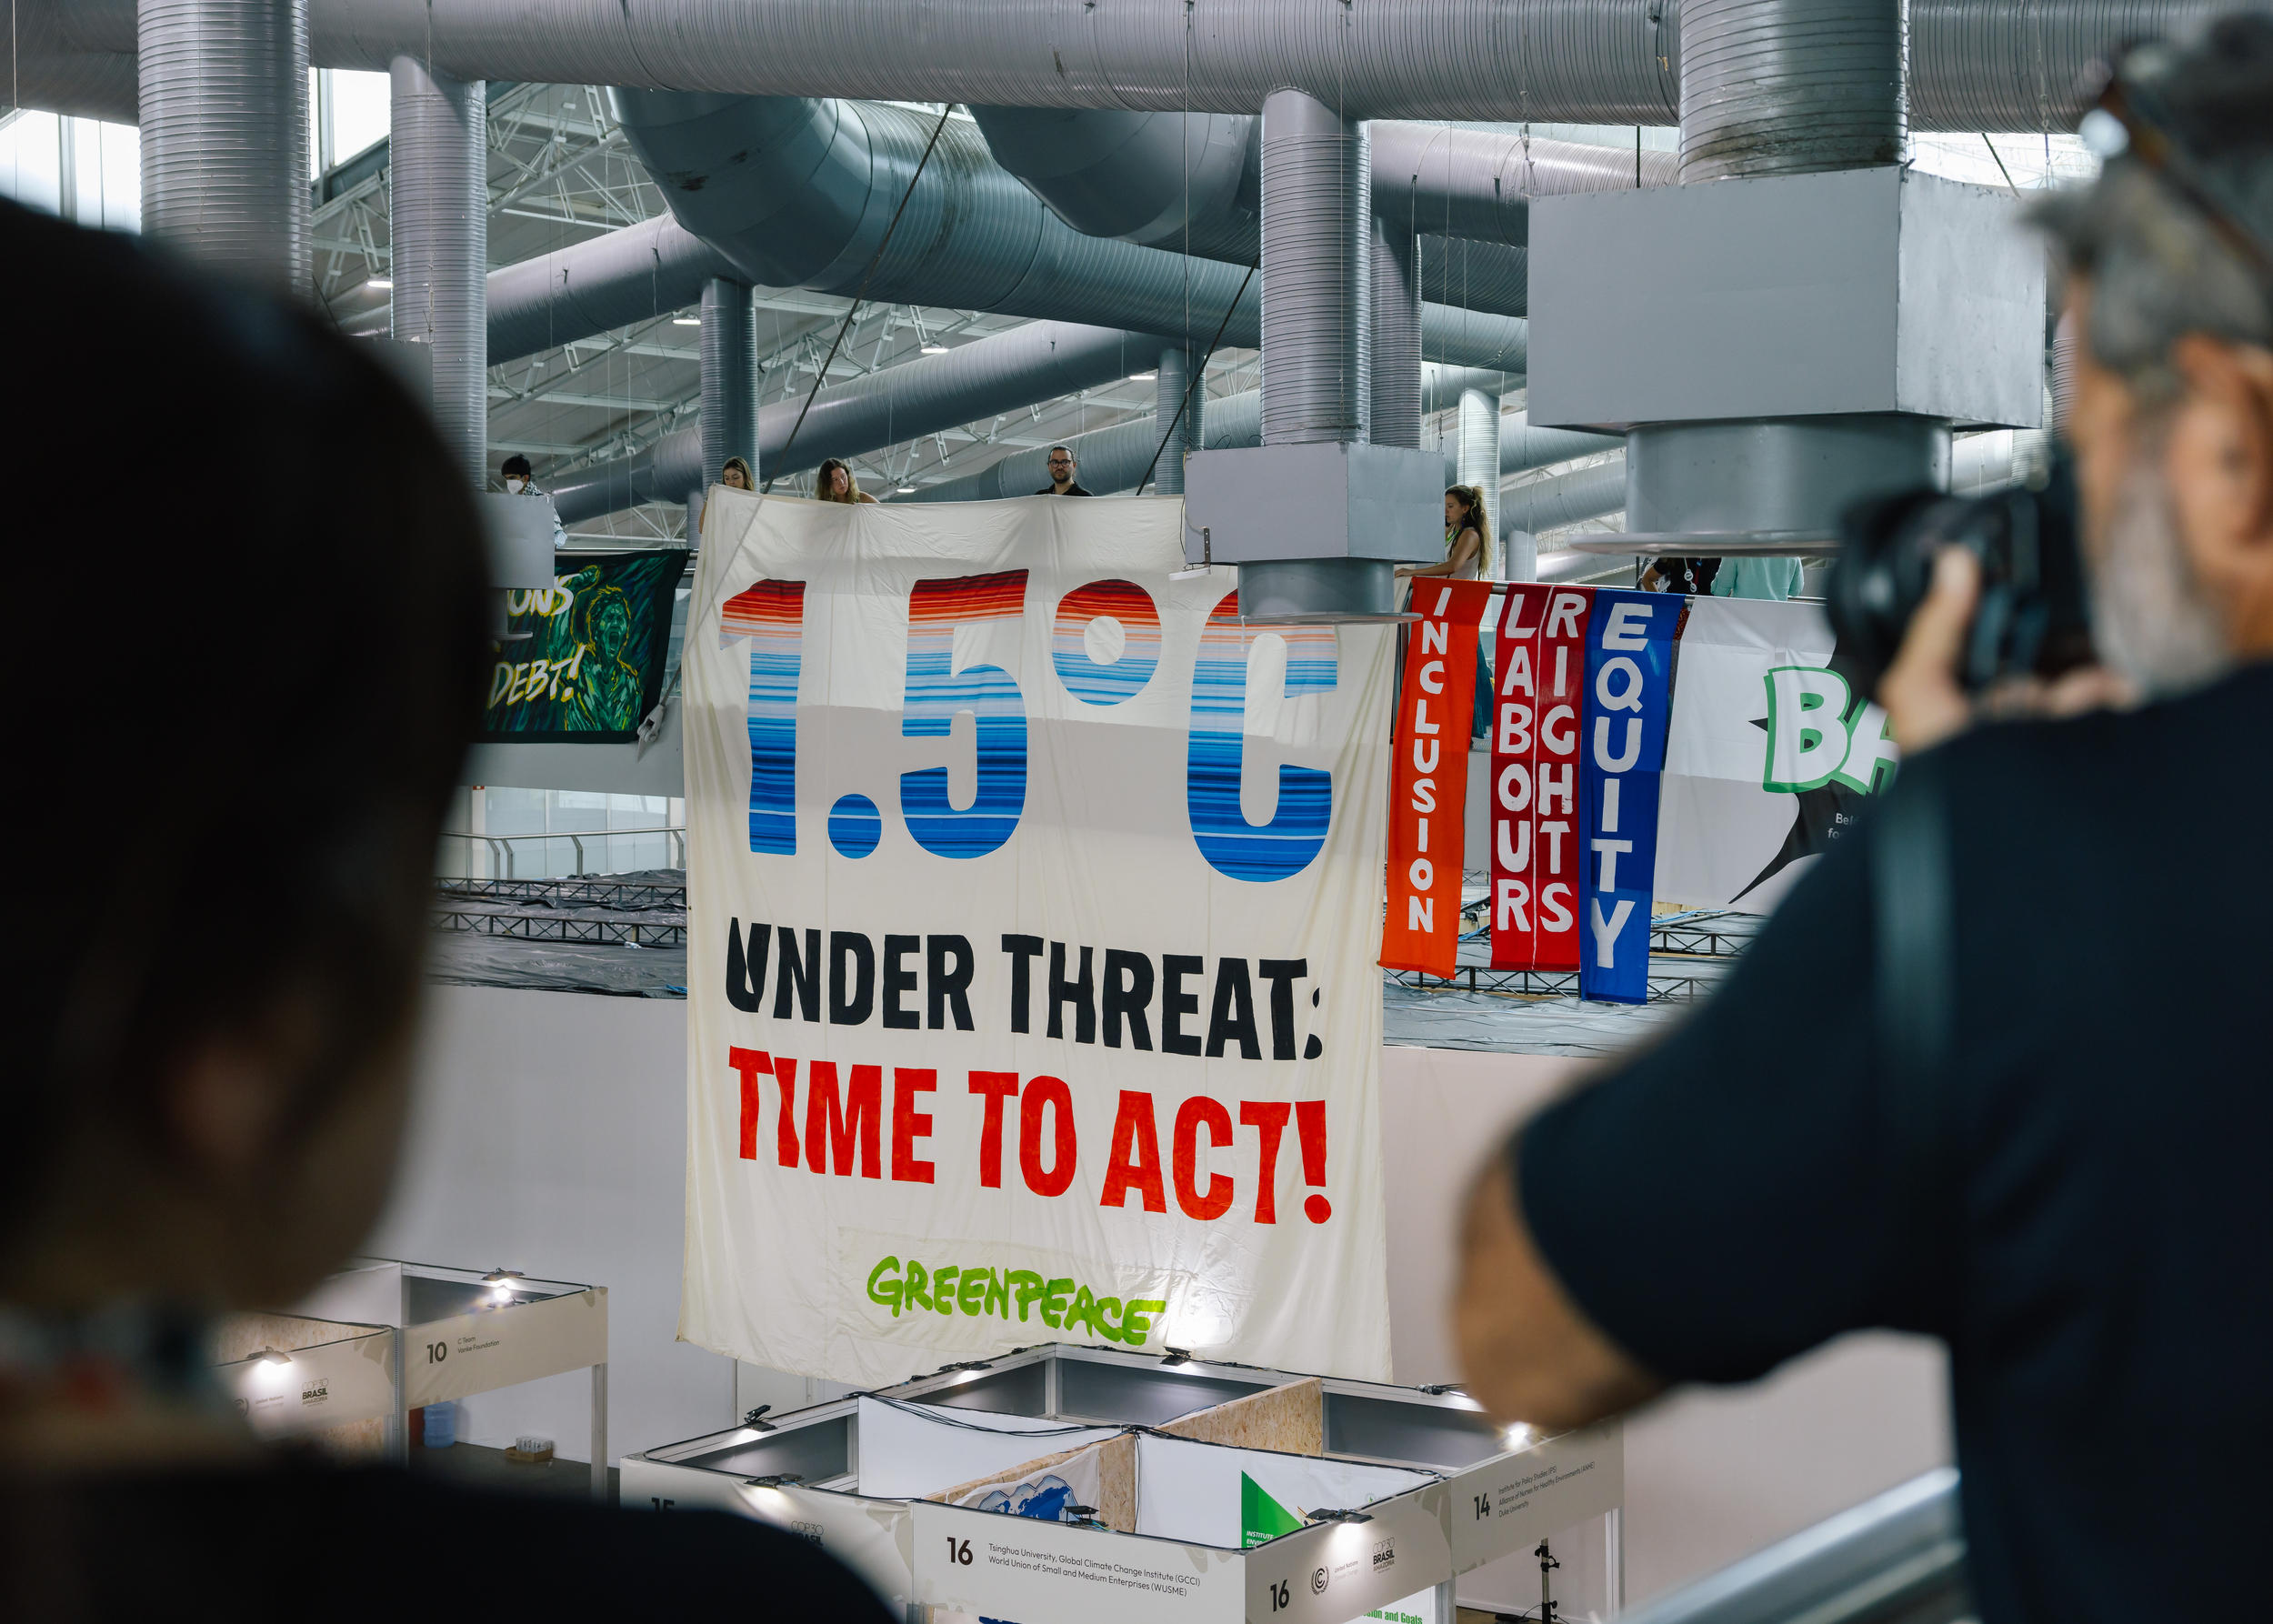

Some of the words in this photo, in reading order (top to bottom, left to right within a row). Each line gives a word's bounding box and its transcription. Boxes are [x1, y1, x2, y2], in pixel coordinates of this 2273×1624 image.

[486, 644, 586, 710] DEBT!
[1763, 666, 1902, 797] BA
[1408, 586, 1452, 934] INCLUSION
[1497, 593, 1537, 933] LABOUR
[1537, 593, 1587, 934] RIGHTS
[1591, 602, 1654, 969] EQUITY
[1827, 827, 1843, 839] fo
[1835, 812, 1859, 826] Bel
[726, 917, 975, 1032] UNDER
[1001, 934, 1323, 1061] THREAT:
[728, 1045, 938, 1185] TIME
[968, 1070, 1077, 1198] TO
[1099, 1089, 1333, 1225] ACT!
[866, 1255, 1167, 1345] GREENPEACE
[426, 1341, 447, 1364] 10
[472, 1340, 500, 1351] Foundation
[302, 1388, 328, 1400] BRASIL
[1498, 1494, 1515, 1506] Alliance
[1539, 1479, 1556, 1490] Healthy
[1555, 1469, 1581, 1483] Environments
[1521, 1477, 1534, 1487] Policy
[1533, 1470, 1548, 1481] Studies
[1474, 1492, 1491, 1520] 14
[1498, 1508, 1509, 1518] Duke
[1509, 1500, 1529, 1514] University
[791, 1520, 825, 1536] COP30
[1246, 1530, 1275, 1540] INSTITUTE
[946, 1537, 974, 1566] 16
[1373, 1537, 1396, 1554] COP30
[1373, 1549, 1395, 1565] BRASIL
[988, 1542, 1019, 1556] Tsinghua
[1020, 1549, 1057, 1563] University,
[1058, 1555, 1083, 1567] Global
[1084, 1559, 1113, 1571] Climate
[1113, 1563, 1143, 1578] Change
[1144, 1569, 1174, 1582] Institute
[1175, 1574, 1201, 1587] (GCCI)
[988, 1555, 1010, 1567] World
[1010, 1560, 1032, 1570] Union
[1032, 1563, 1041, 1572] of
[1042, 1564, 1062, 1576] Small
[1062, 1569, 1076, 1579] and
[1077, 1570, 1107, 1583] Medium
[1108, 1576, 1150, 1590] Enterprises
[1151, 1583, 1187, 1598] (WUSME)
[1270, 1579, 1290, 1612] 16
[1384, 1610, 1398, 1622] and
[1400, 1612, 1423, 1624] Goals
